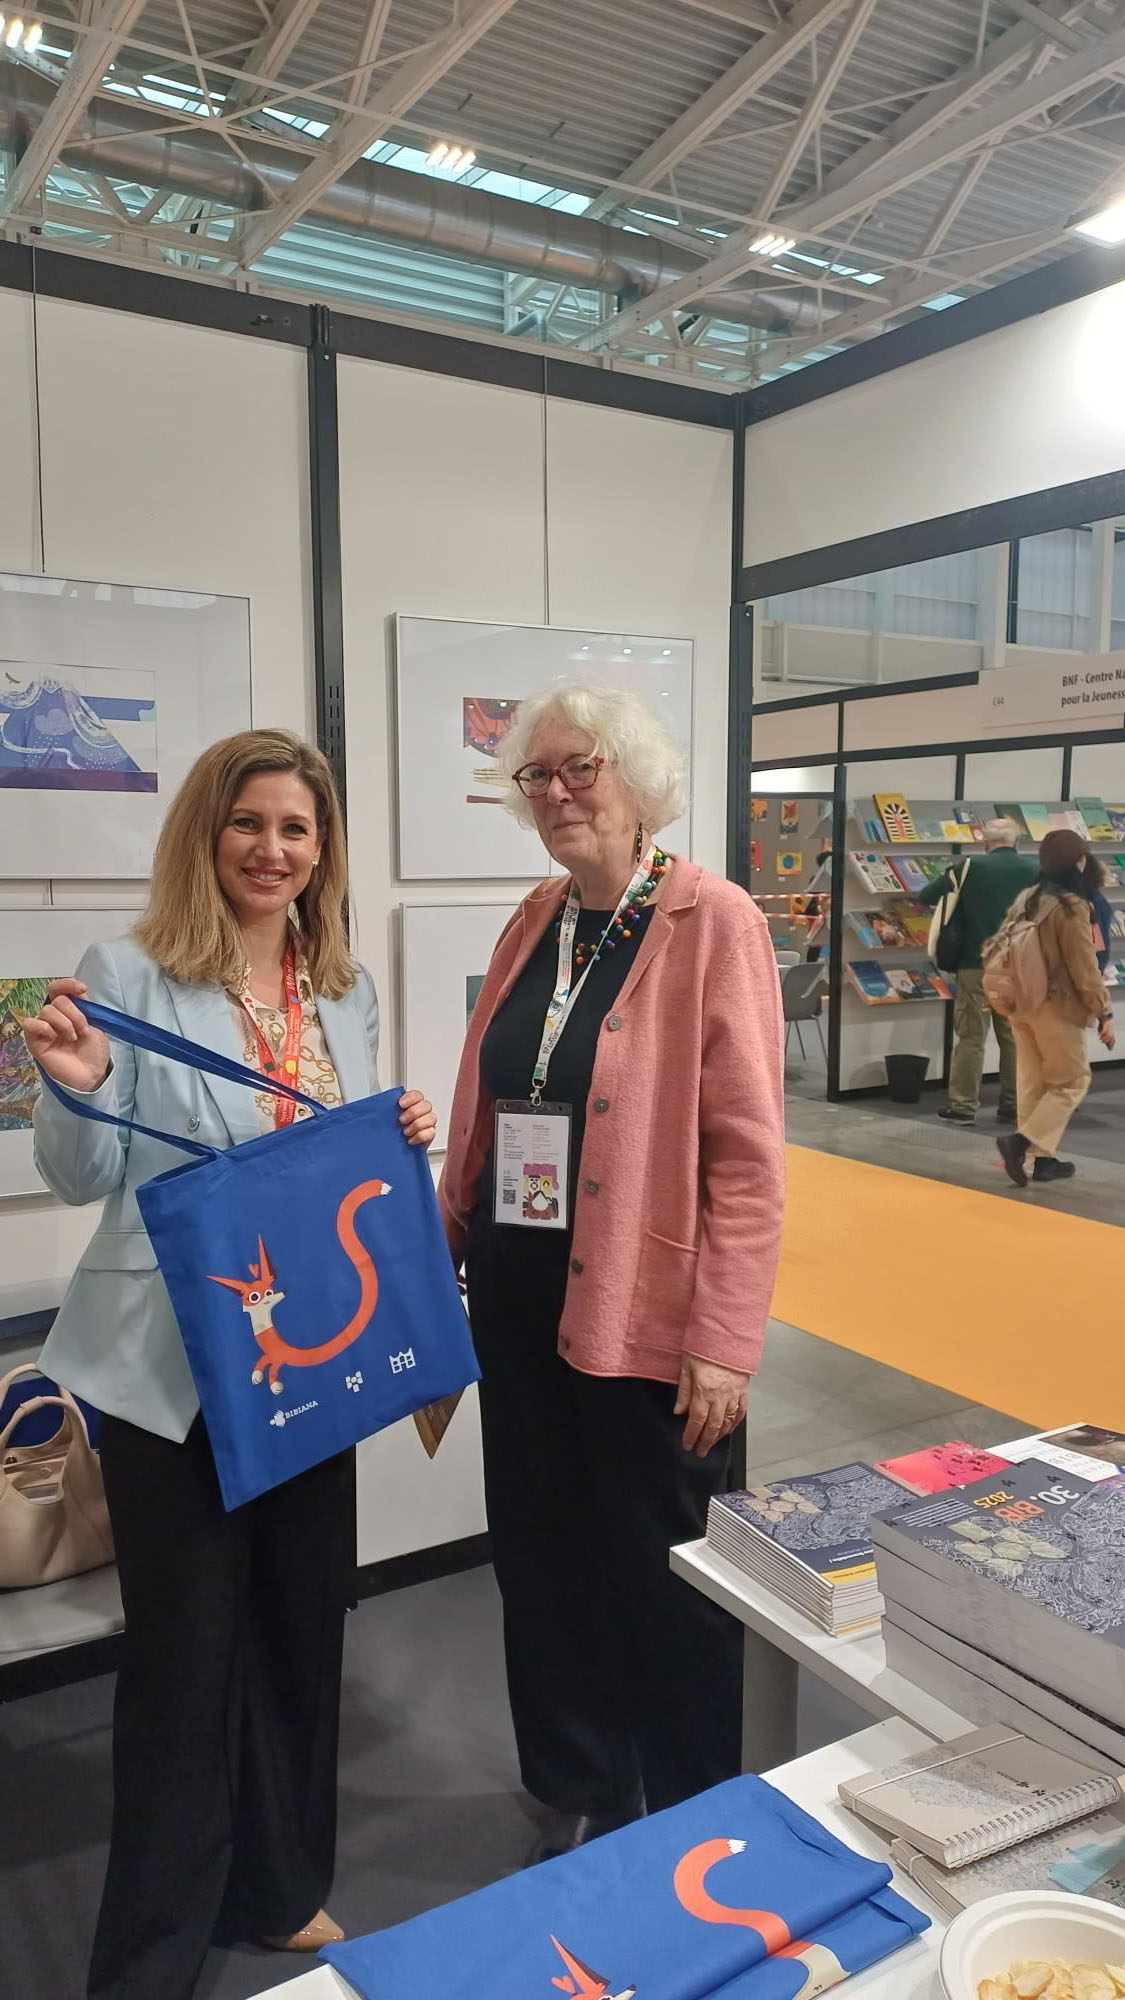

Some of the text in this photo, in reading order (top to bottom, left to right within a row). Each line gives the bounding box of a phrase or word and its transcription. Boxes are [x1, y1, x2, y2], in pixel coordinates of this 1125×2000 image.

[1062, 674, 1079, 687] BNF
[1085, 671, 1114, 684] Centre
[1061, 695, 1080, 708] pour
[1082, 692, 1090, 703] la
[285, 1401, 319, 1419] BIBIANA
[972, 1491, 1015, 1509] 2025
[993, 1485, 1080, 1523] 30. BIB
